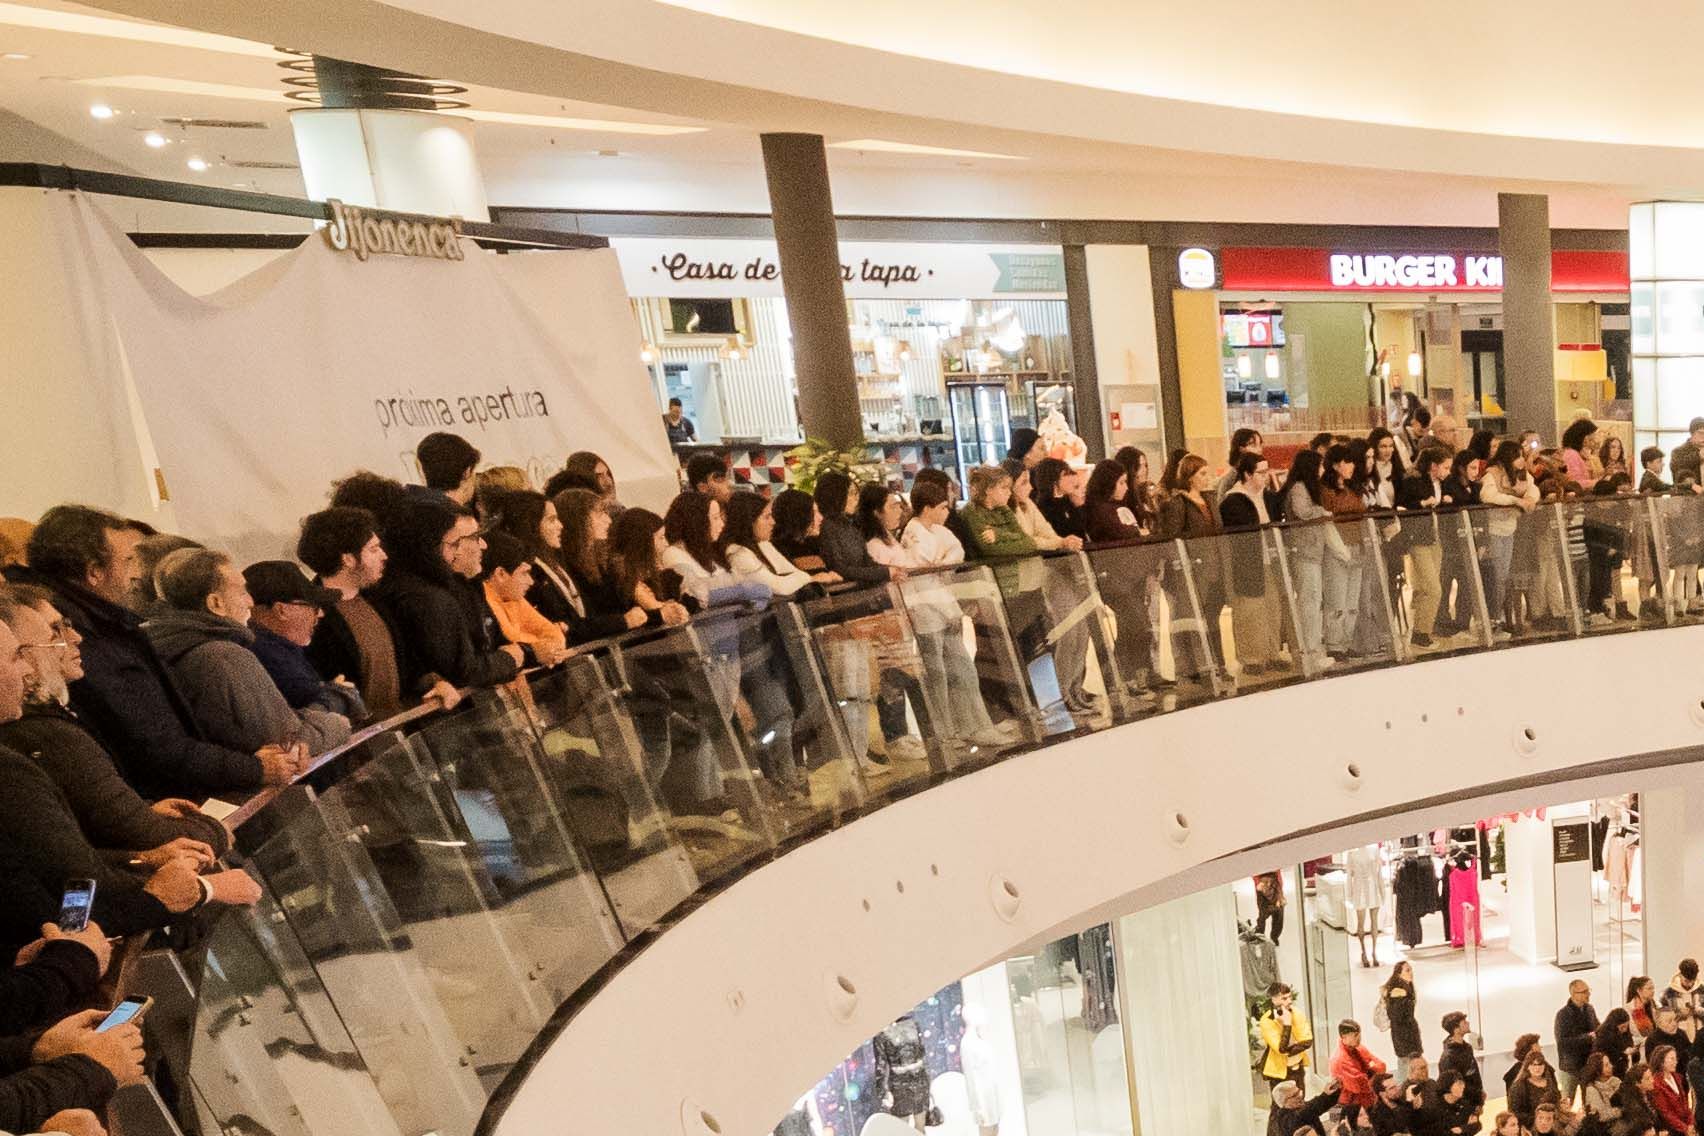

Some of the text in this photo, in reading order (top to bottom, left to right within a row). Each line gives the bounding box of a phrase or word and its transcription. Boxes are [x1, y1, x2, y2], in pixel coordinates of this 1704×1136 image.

[328, 199, 465, 261] Jijonenca
[662, 253, 738, 280] Casa
[745, 257, 779, 280] de
[861, 258, 920, 288] tapa
[1331, 254, 1504, 287] BURGER KI
[458, 385, 549, 431] apertura
